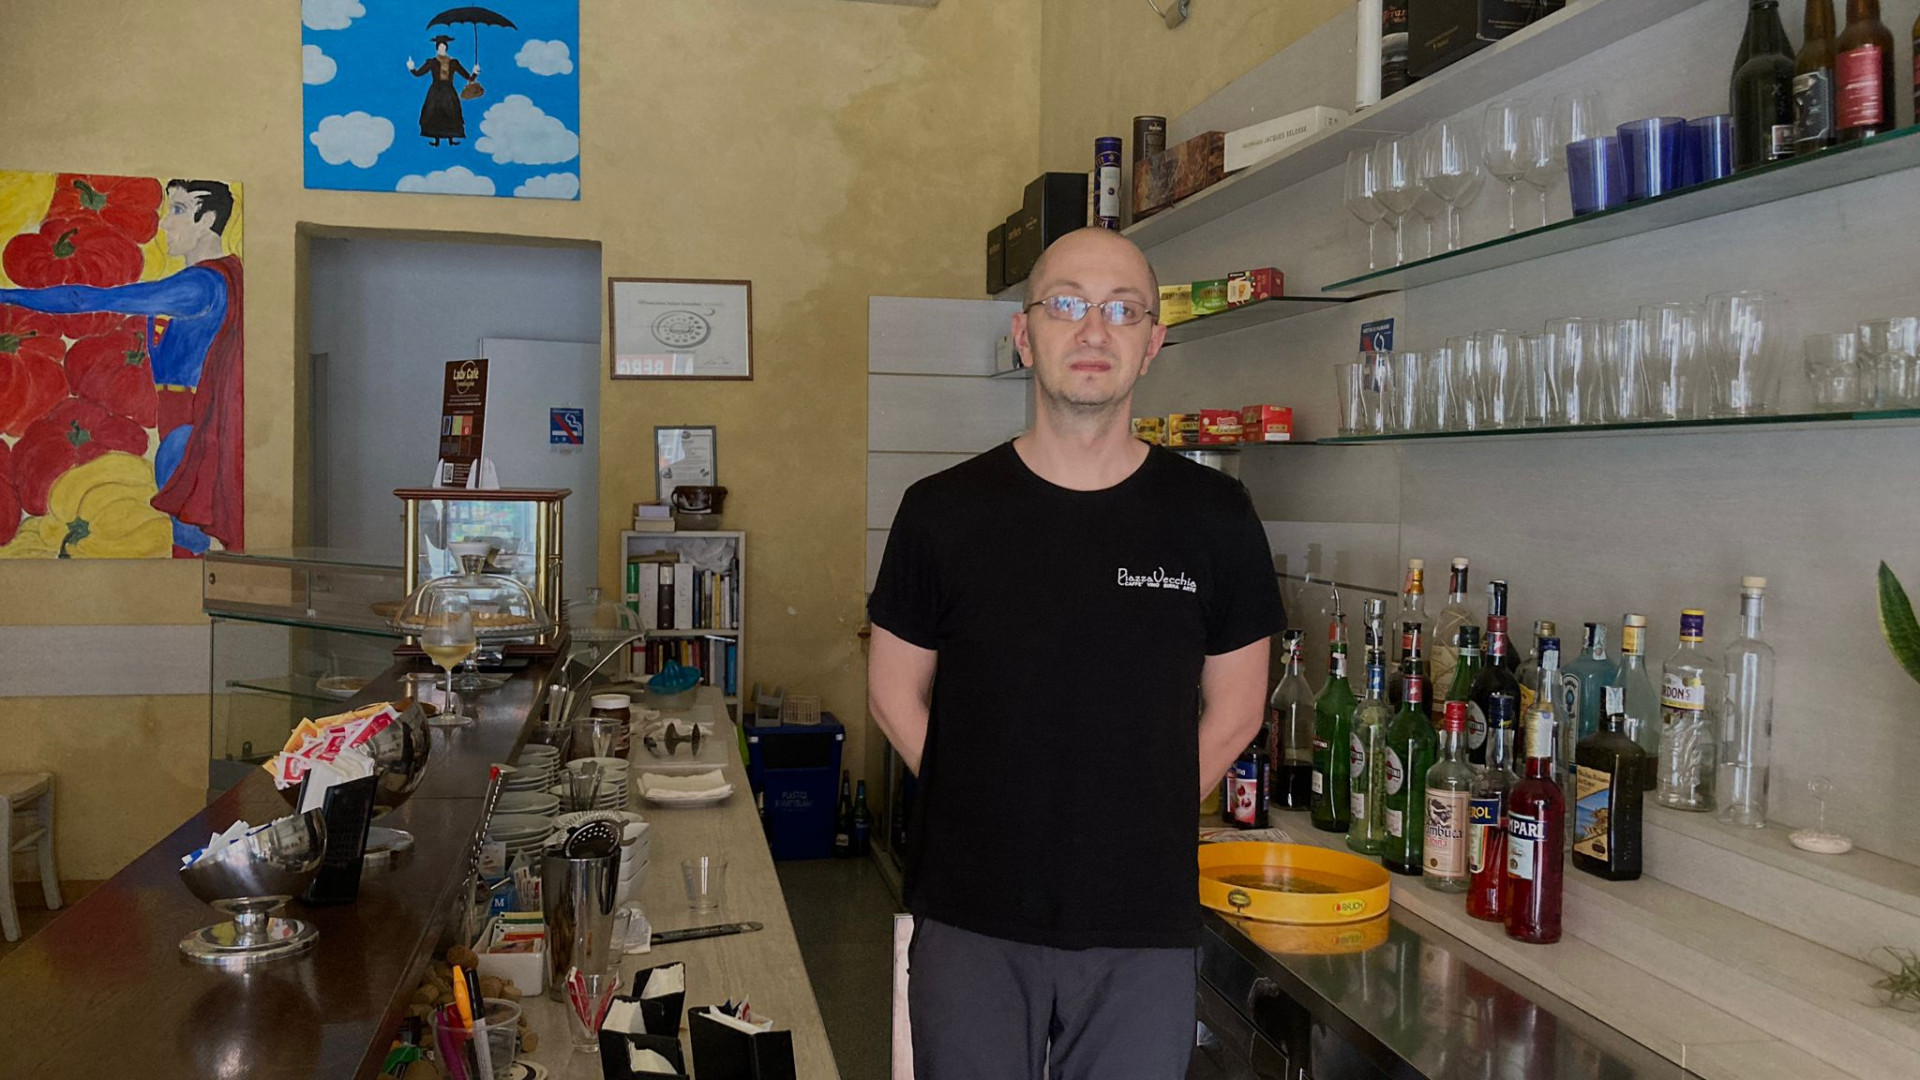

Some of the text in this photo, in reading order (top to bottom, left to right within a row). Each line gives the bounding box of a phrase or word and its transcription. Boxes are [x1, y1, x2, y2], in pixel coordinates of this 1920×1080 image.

[1425, 825, 1462, 839] ambuca
[1508, 818, 1545, 839] MPARI
[494, 898, 505, 908] M
